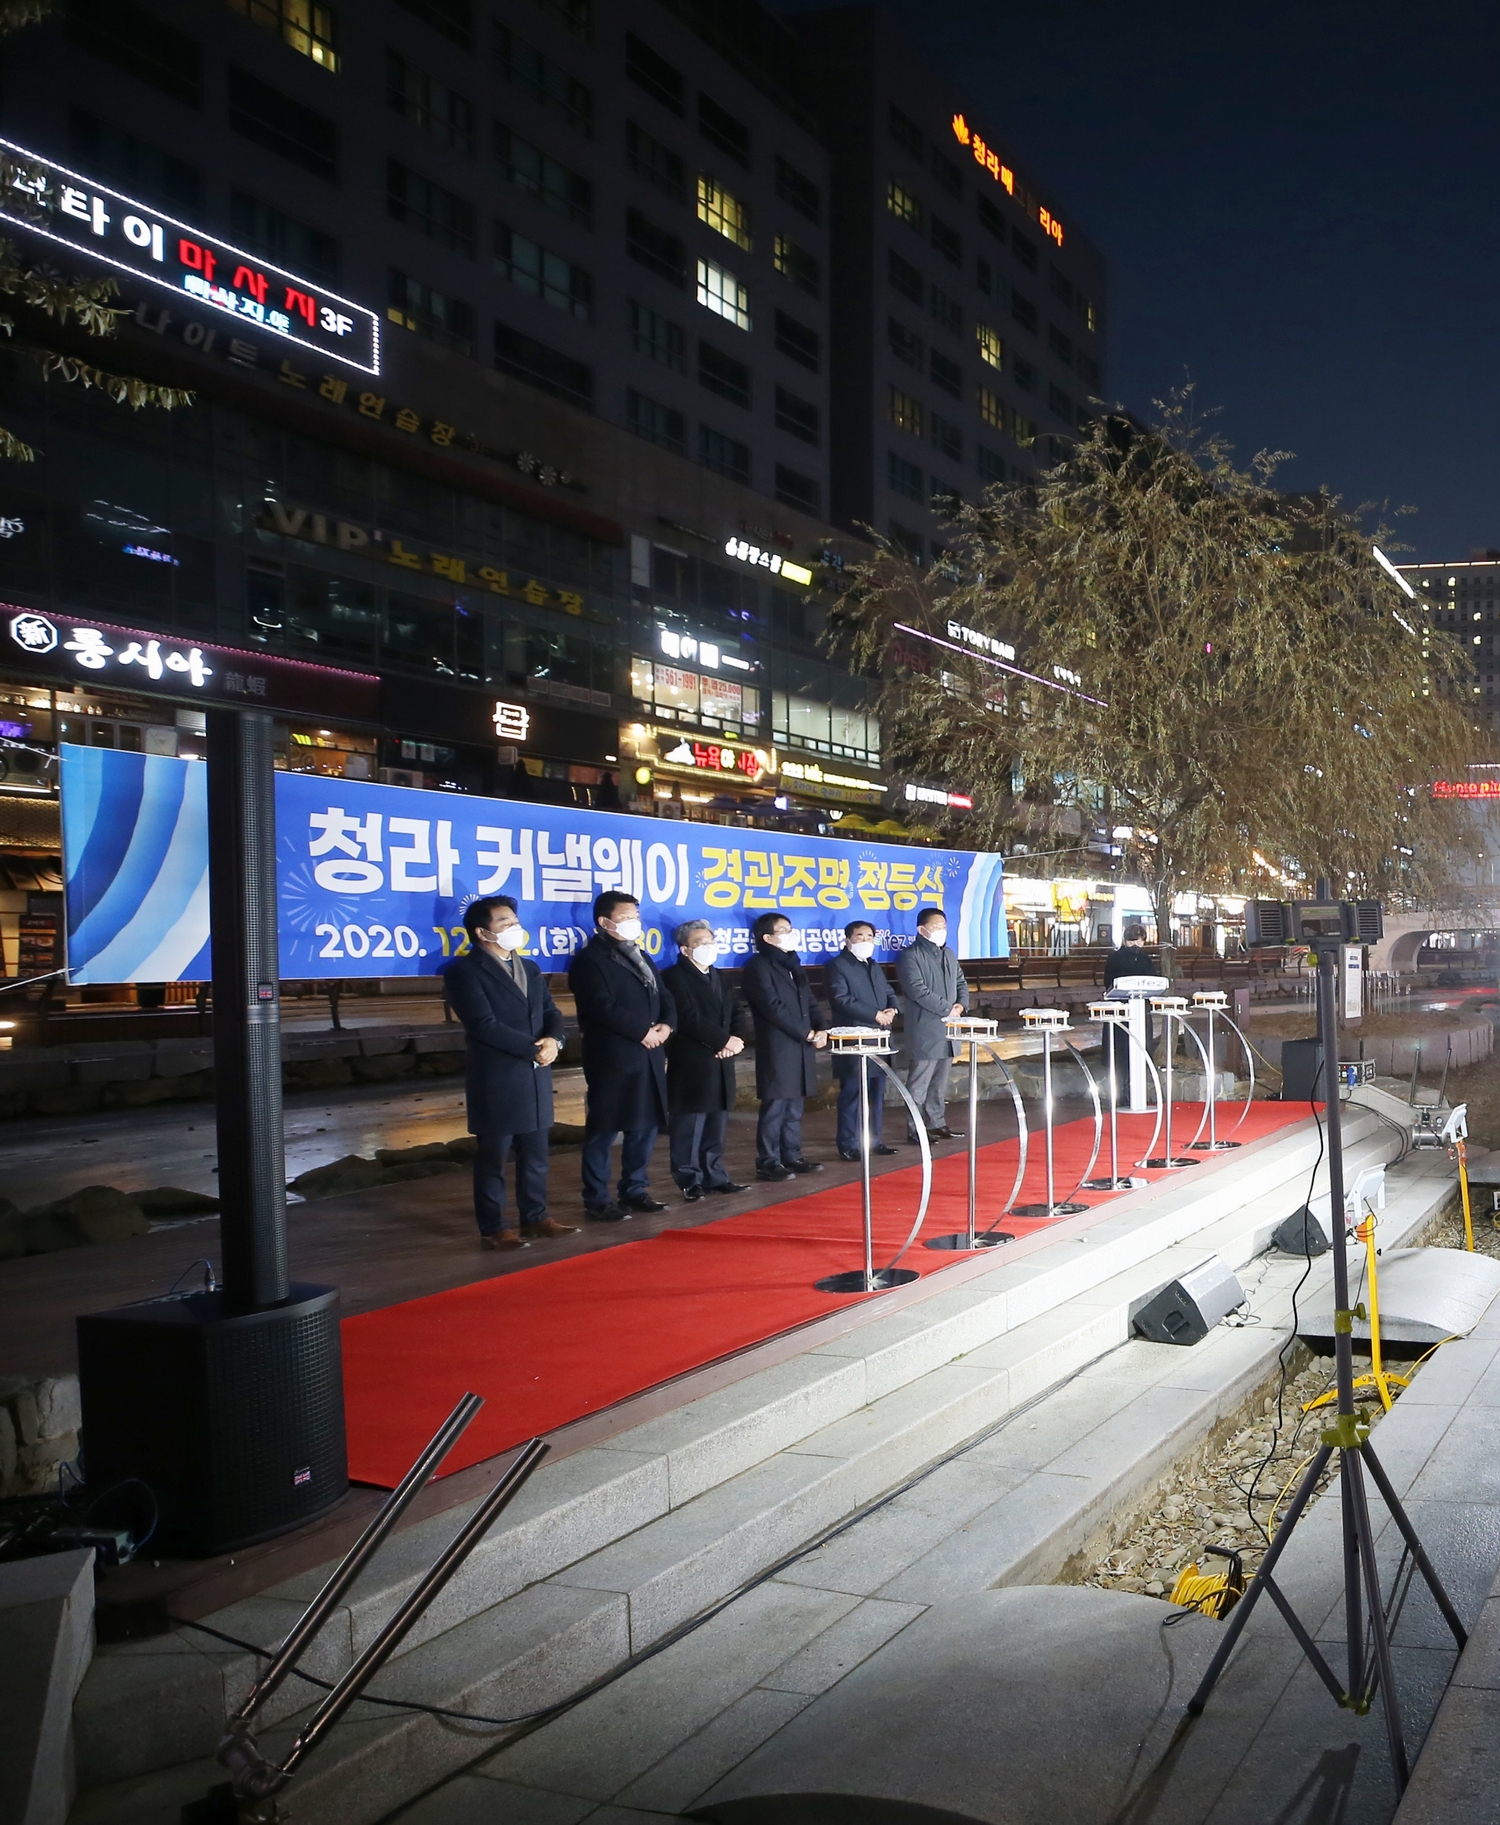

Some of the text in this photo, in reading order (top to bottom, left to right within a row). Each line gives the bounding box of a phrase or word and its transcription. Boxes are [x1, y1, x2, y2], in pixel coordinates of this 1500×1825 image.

[179, 239, 317, 327] 마사지
[320, 306, 353, 336] 3F
[135, 301, 260, 369] 나이트
[278, 358, 457, 447] 노래연습장
[389, 540, 585, 616] 노래연습장
[962, 627, 990, 649] TORY
[308, 806, 945, 911] 청라 커낼웨이 경관조명 점등식
[315, 923, 427, 958] 2020.
